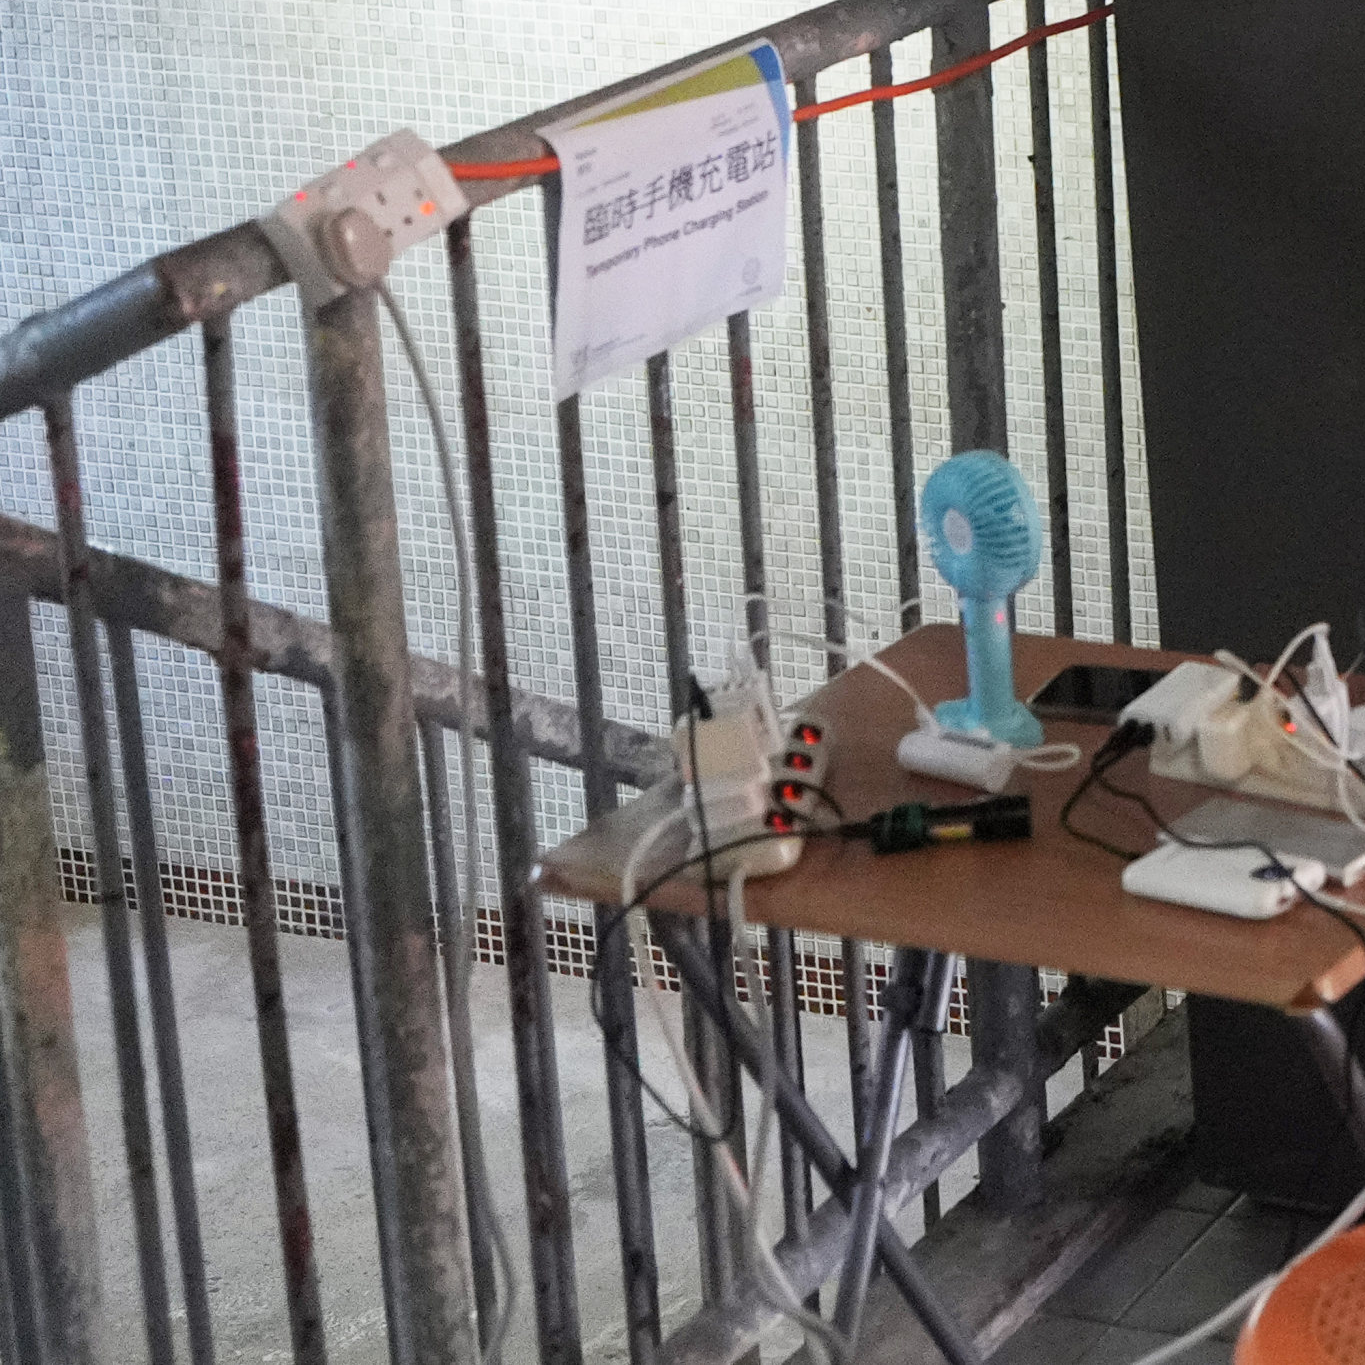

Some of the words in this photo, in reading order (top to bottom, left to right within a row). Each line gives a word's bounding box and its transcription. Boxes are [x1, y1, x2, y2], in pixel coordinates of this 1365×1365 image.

[583, 130, 776, 245] 臨時手機充電站
[643, 228, 681, 250] Phone
[682, 208, 733, 235] Charging
